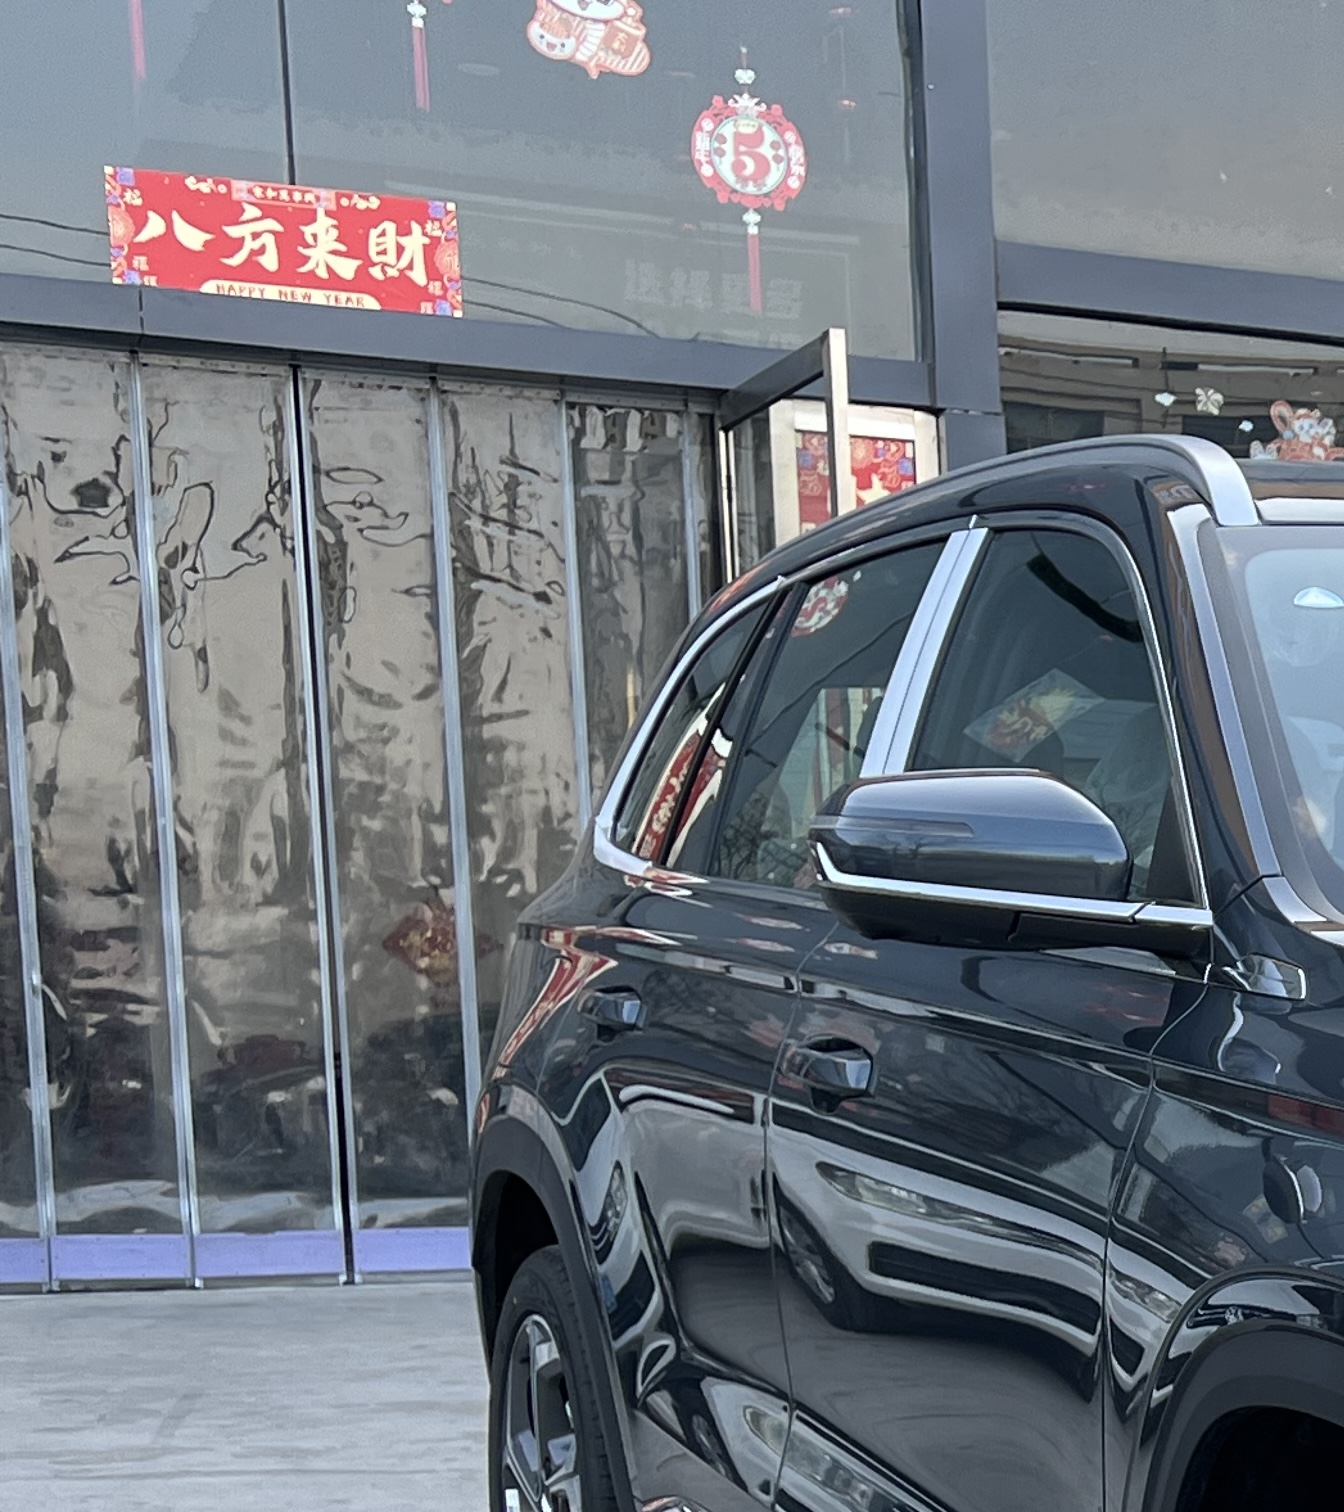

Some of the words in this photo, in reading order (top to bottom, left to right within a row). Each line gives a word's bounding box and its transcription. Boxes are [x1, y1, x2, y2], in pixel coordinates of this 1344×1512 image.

[215, 283, 266, 299] HAPPY
[278, 289, 312, 303] NEW
[323, 292, 366, 308] YEAR
